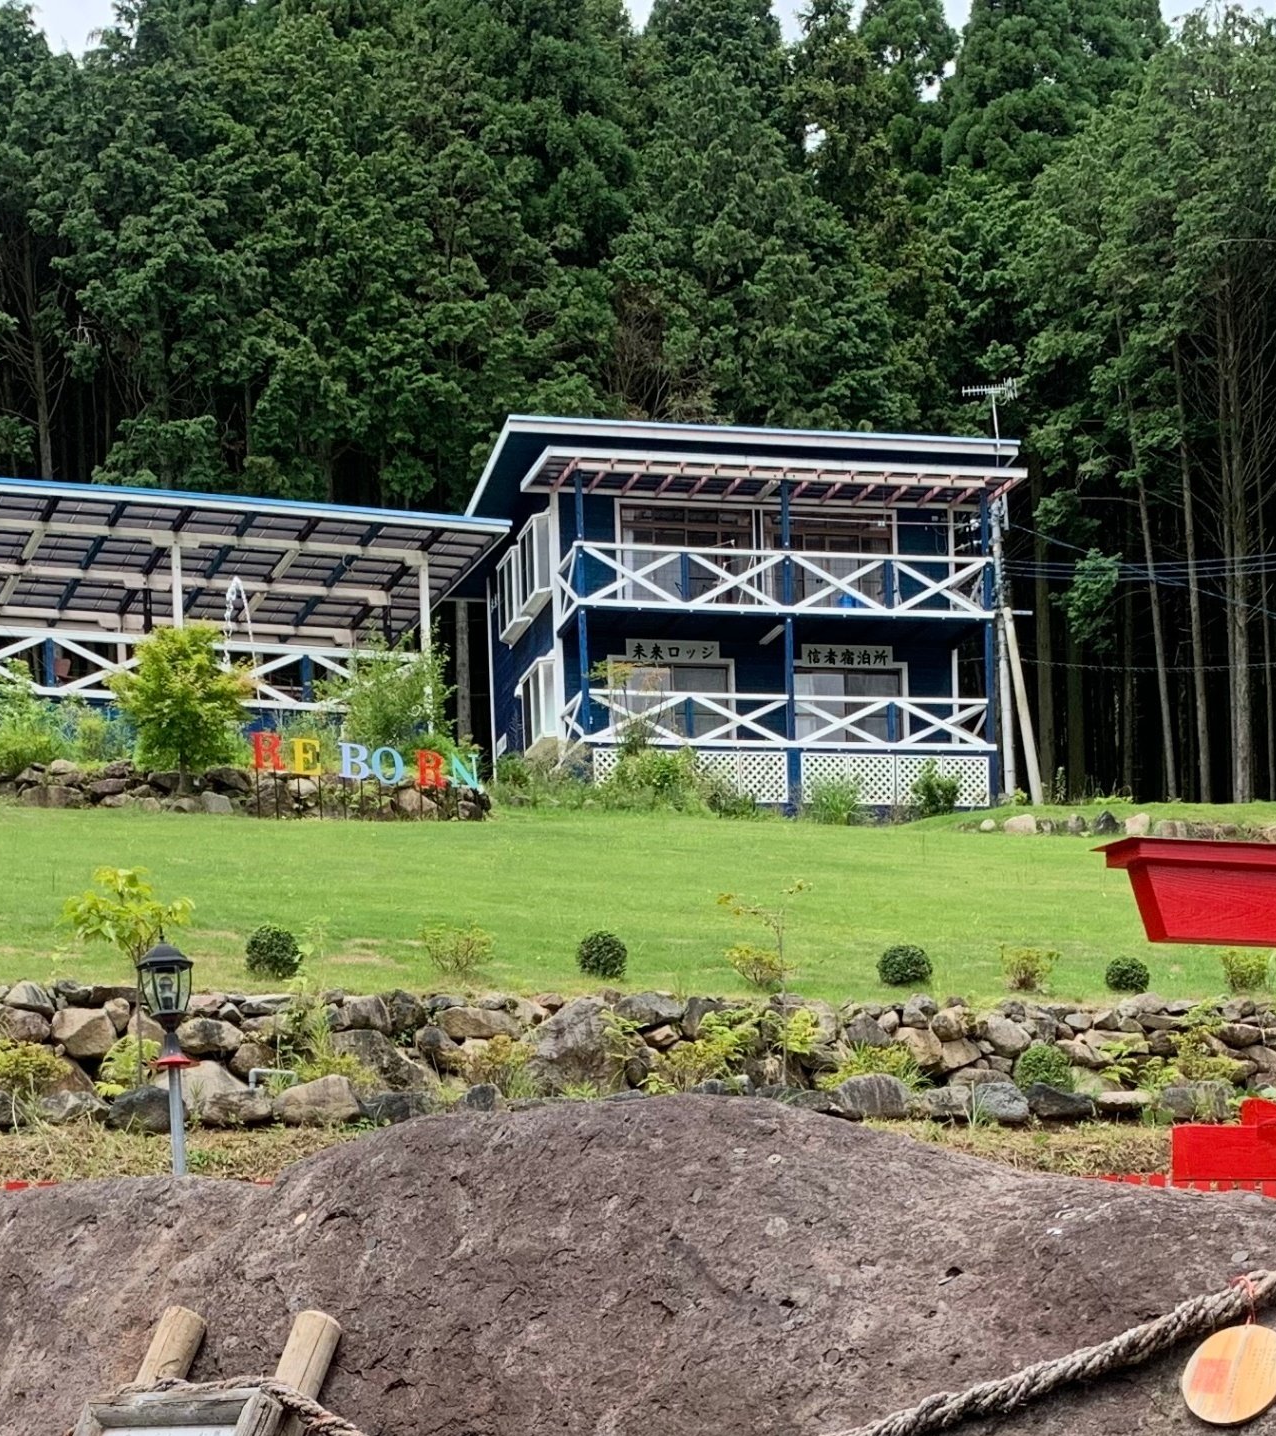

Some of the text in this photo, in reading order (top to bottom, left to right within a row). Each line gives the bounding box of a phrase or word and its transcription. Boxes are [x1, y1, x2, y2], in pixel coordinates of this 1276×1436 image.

[632, 643, 715, 661] 未来ロッジ
[807, 647, 889, 667] 信者宿泊所
[251, 731, 480, 789] RE BORN
